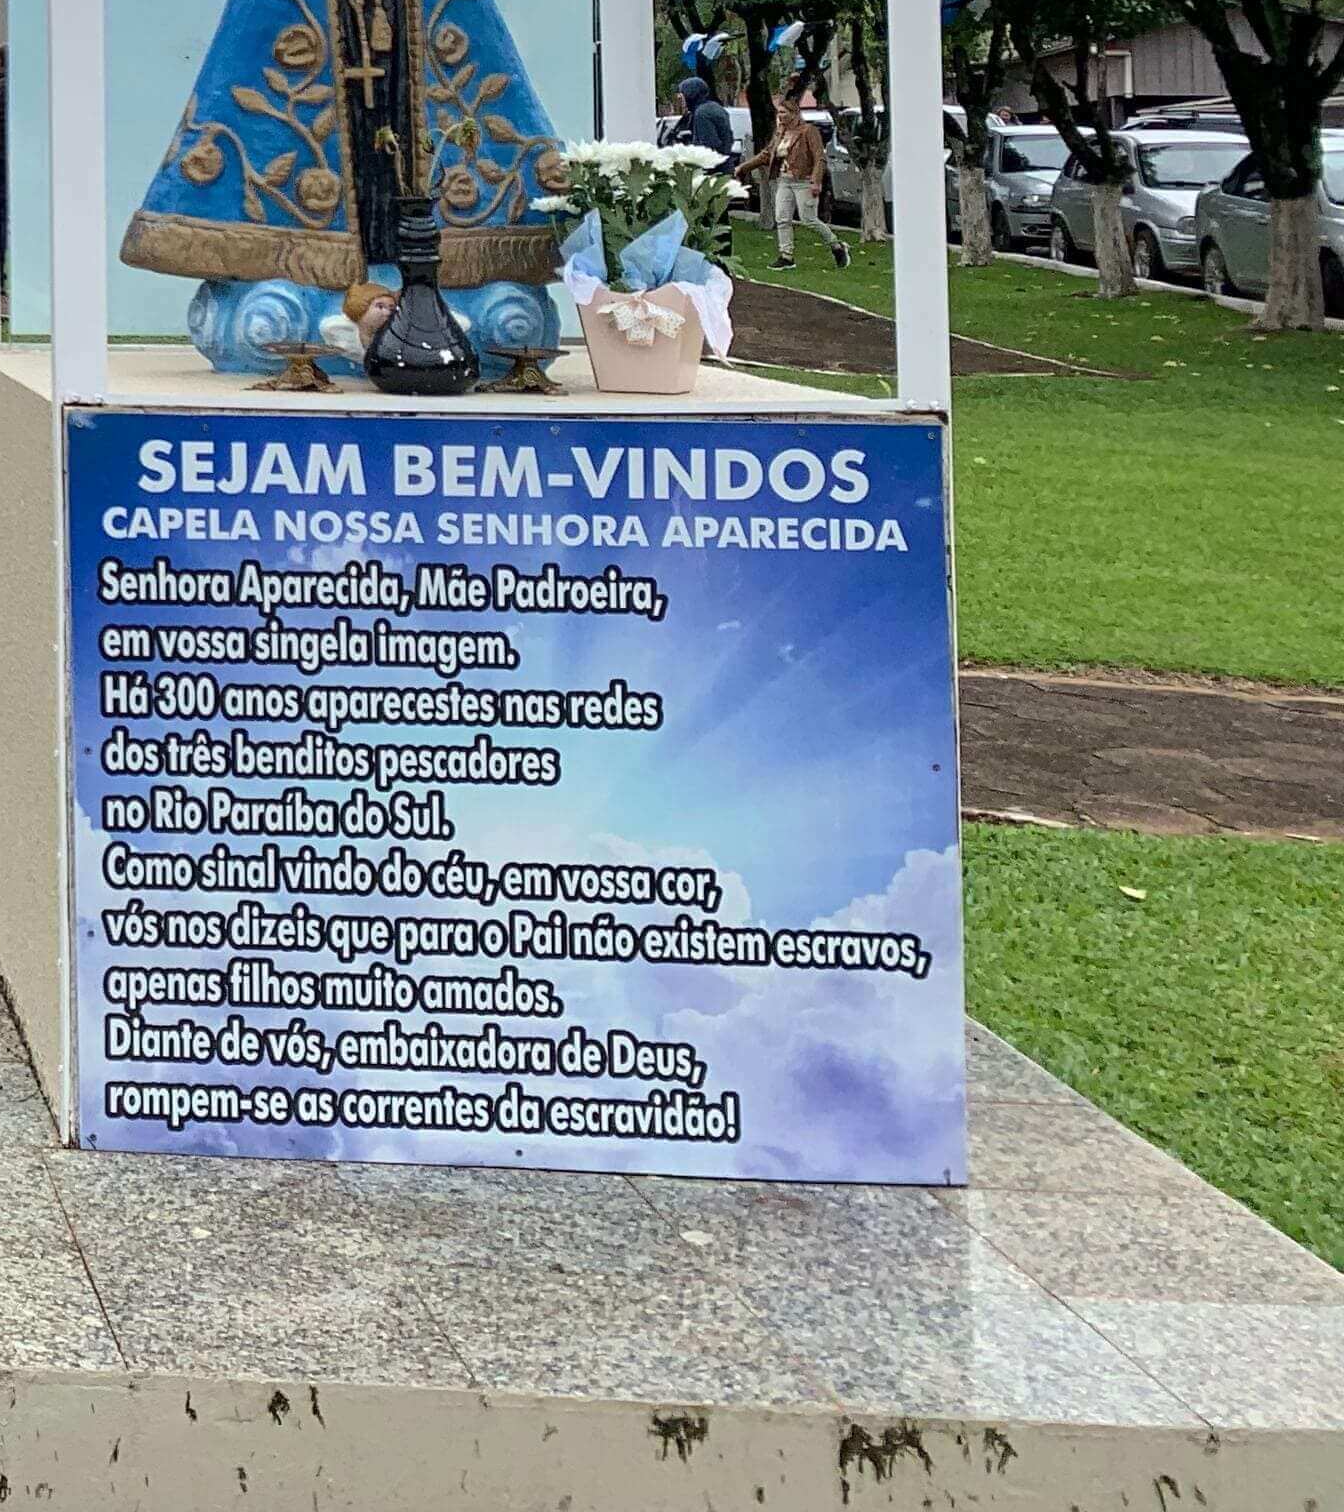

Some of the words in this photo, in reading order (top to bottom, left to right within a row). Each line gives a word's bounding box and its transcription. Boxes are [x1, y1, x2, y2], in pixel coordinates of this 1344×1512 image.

[138, 439, 366, 495] SEJAM
[394, 444, 869, 503] BEM-VINDOS
[103, 506, 261, 541] CAPELA
[274, 510, 425, 544] NOSSA
[437, 512, 650, 547] SENHORA
[661, 515, 908, 551] APARECIDA
[101, 560, 231, 603] Senhora
[238, 563, 411, 614] Aparecida,
[418, 566, 487, 608] Mãe
[496, 566, 664, 618] Padroeira,
[102, 628, 151, 658] em
[157, 629, 246, 660] vossa
[254, 620, 369, 672] singela
[377, 622, 516, 675] imagem.
[104, 674, 149, 715] Há
[157, 675, 216, 719] 300
[224, 687, 300, 719] anos
[307, 685, 496, 730] aparecestes
[504, 693, 562, 725] nas
[569, 683, 659, 727] redes
[104, 729, 162, 773] dos
[166, 731, 231, 774] três
[235, 732, 371, 778] benditos
[378, 737, 557, 788] pescadores
[105, 798, 146, 829] no
[154, 789, 203, 831] Rio
[211, 790, 335, 834] Paraíba
[343, 792, 385, 835] do
[392, 794, 451, 837] Sul.
[106, 845, 194, 887] Como
[201, 846, 276, 890] sinal
[283, 849, 373, 892] vindo
[381, 850, 423, 894] do
[430, 853, 495, 902] céu,
[503, 866, 553, 897] em
[560, 868, 652, 900] vossa
[660, 870, 718, 909] cor,
[105, 902, 159, 944] vós
[167, 914, 223, 946] nos
[230, 904, 322, 949] dizeis
[329, 919, 390, 959] que
[398, 921, 475, 962] para
[483, 923, 504, 954] o
[513, 913, 563, 956] Pai
[572, 917, 635, 958] não
[643, 918, 767, 962] existem
[775, 933, 928, 976] escravos,
[107, 970, 223, 1011] apenas
[229, 960, 316, 1006] filhos
[324, 966, 415, 1009] muito
[422, 969, 560, 1014] amados.
[108, 1016, 212, 1060] Diante
[219, 1018, 261, 1062] de
[267, 1021, 332, 1071] vós,
[339, 1023, 552, 1072] embaixadora
[560, 1030, 603, 1074] de
[611, 1033, 703, 1085] Deus,
[109, 1085, 290, 1128] rompem-se
[297, 1091, 335, 1123] as
[342, 1089, 491, 1128] correntes
[498, 1086, 541, 1130] da
[549, 1093, 737, 1139] escravidão!
